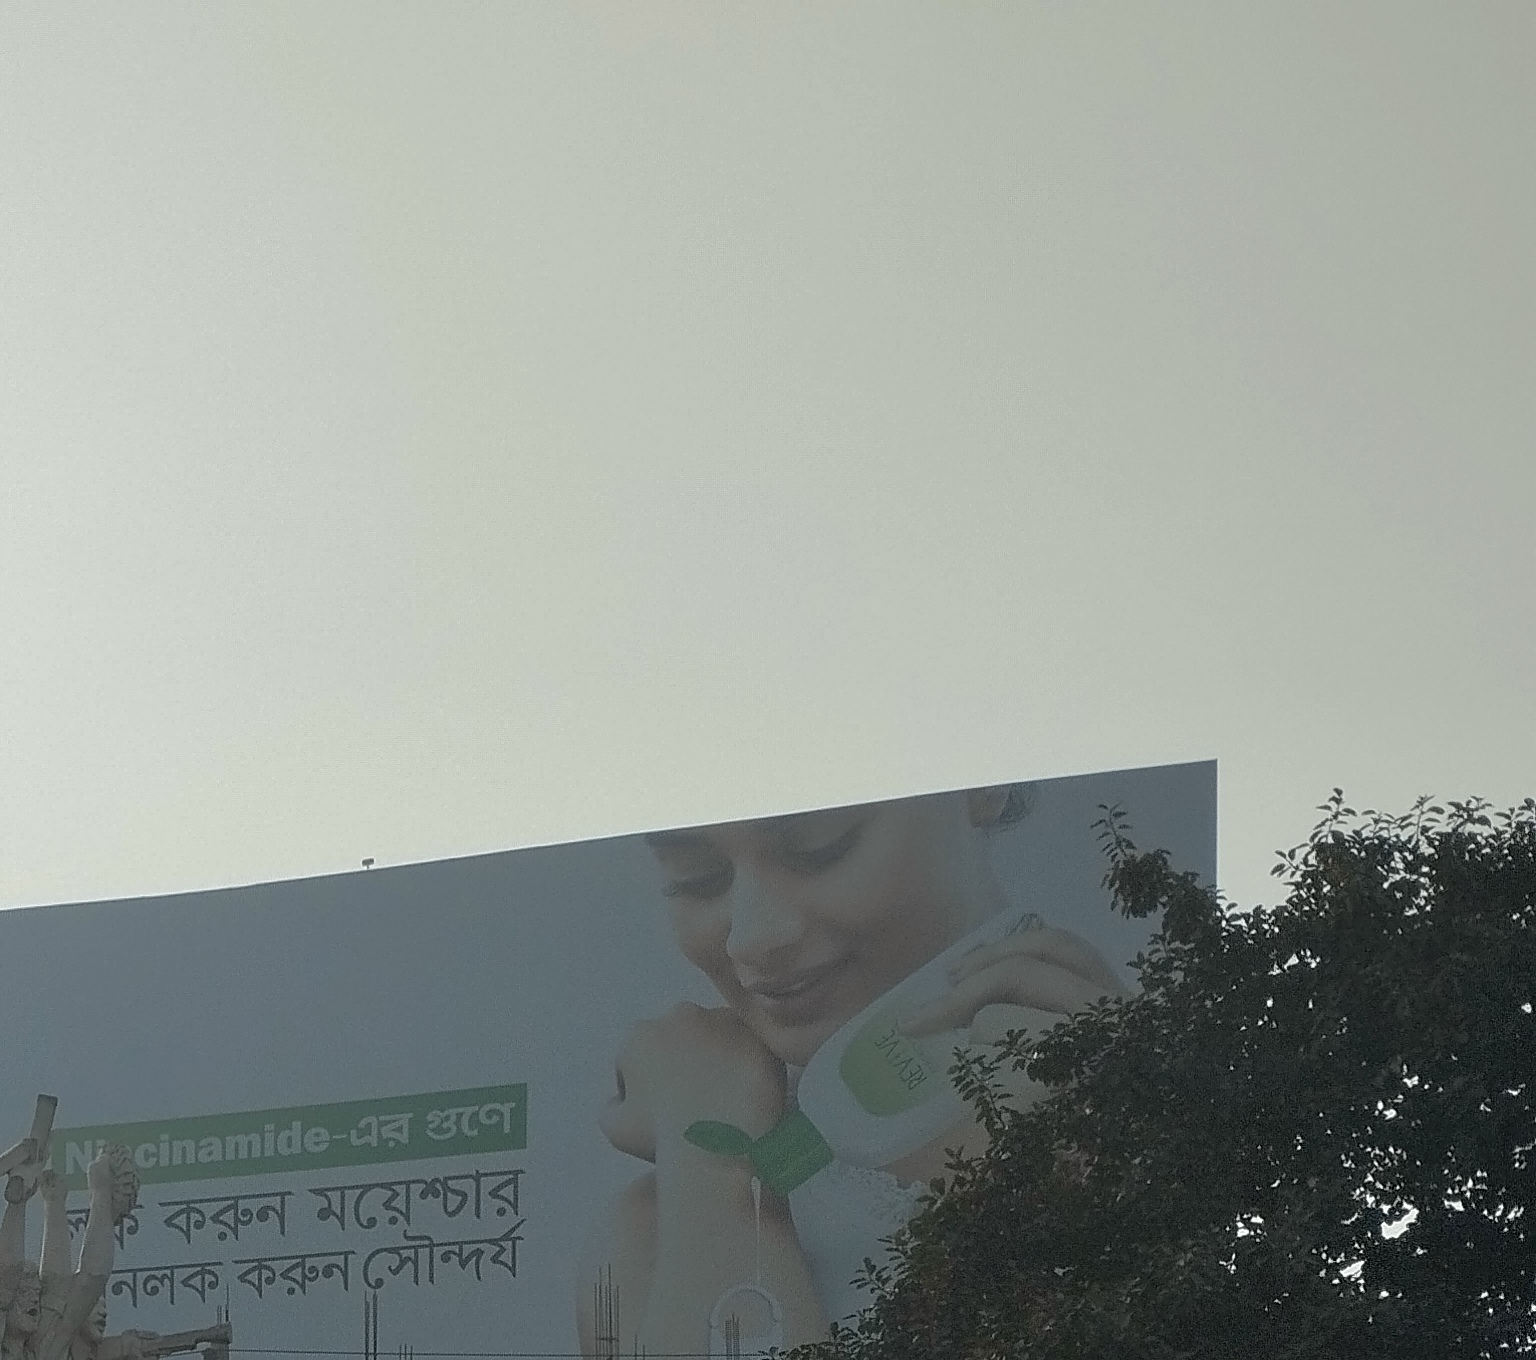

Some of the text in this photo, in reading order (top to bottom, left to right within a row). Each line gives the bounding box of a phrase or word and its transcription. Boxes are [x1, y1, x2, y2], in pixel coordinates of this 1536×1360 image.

[873, 1028, 928, 1091] REVIVE
[64, 1099, 518, 1176] Ncinamide-এর গুণে
[158, 1190, 295, 1245] করুন
[307, 1168, 526, 1232] ময়েশ্চার
[110, 1219, 527, 1308] নলক করুন সৌন্দর্য
